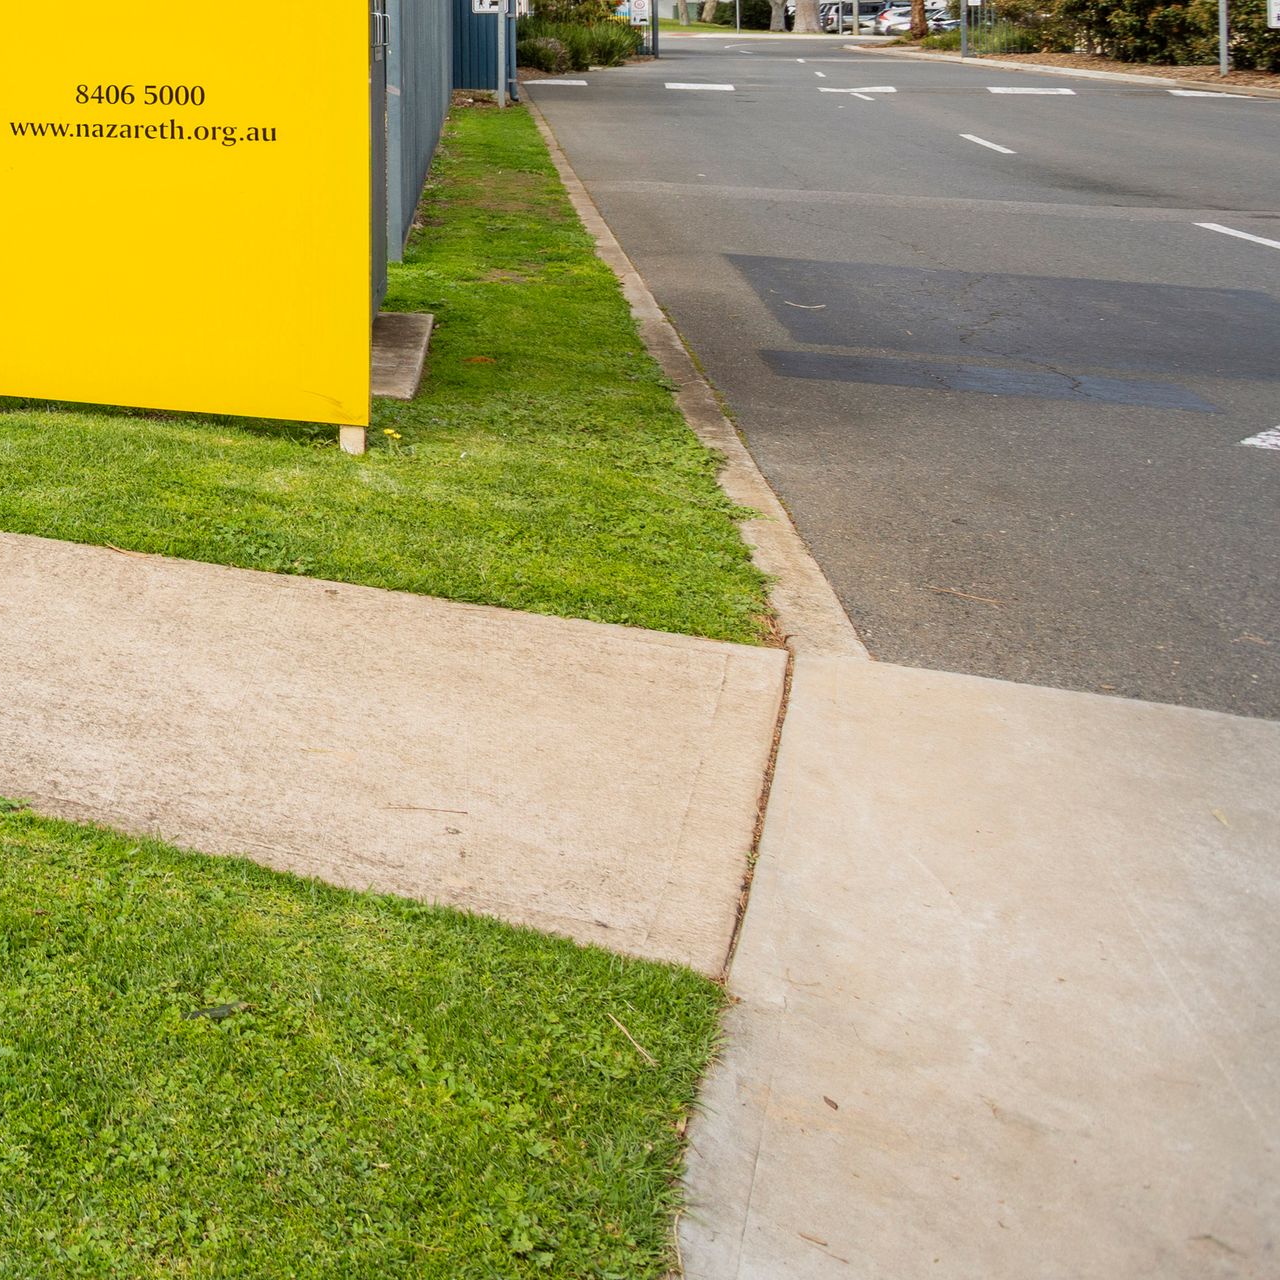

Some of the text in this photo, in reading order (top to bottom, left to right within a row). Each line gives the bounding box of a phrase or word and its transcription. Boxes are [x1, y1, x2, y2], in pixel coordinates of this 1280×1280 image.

[75, 83, 206, 106] 8406 5000
[9, 118, 277, 147] www.nazareth.org.au
